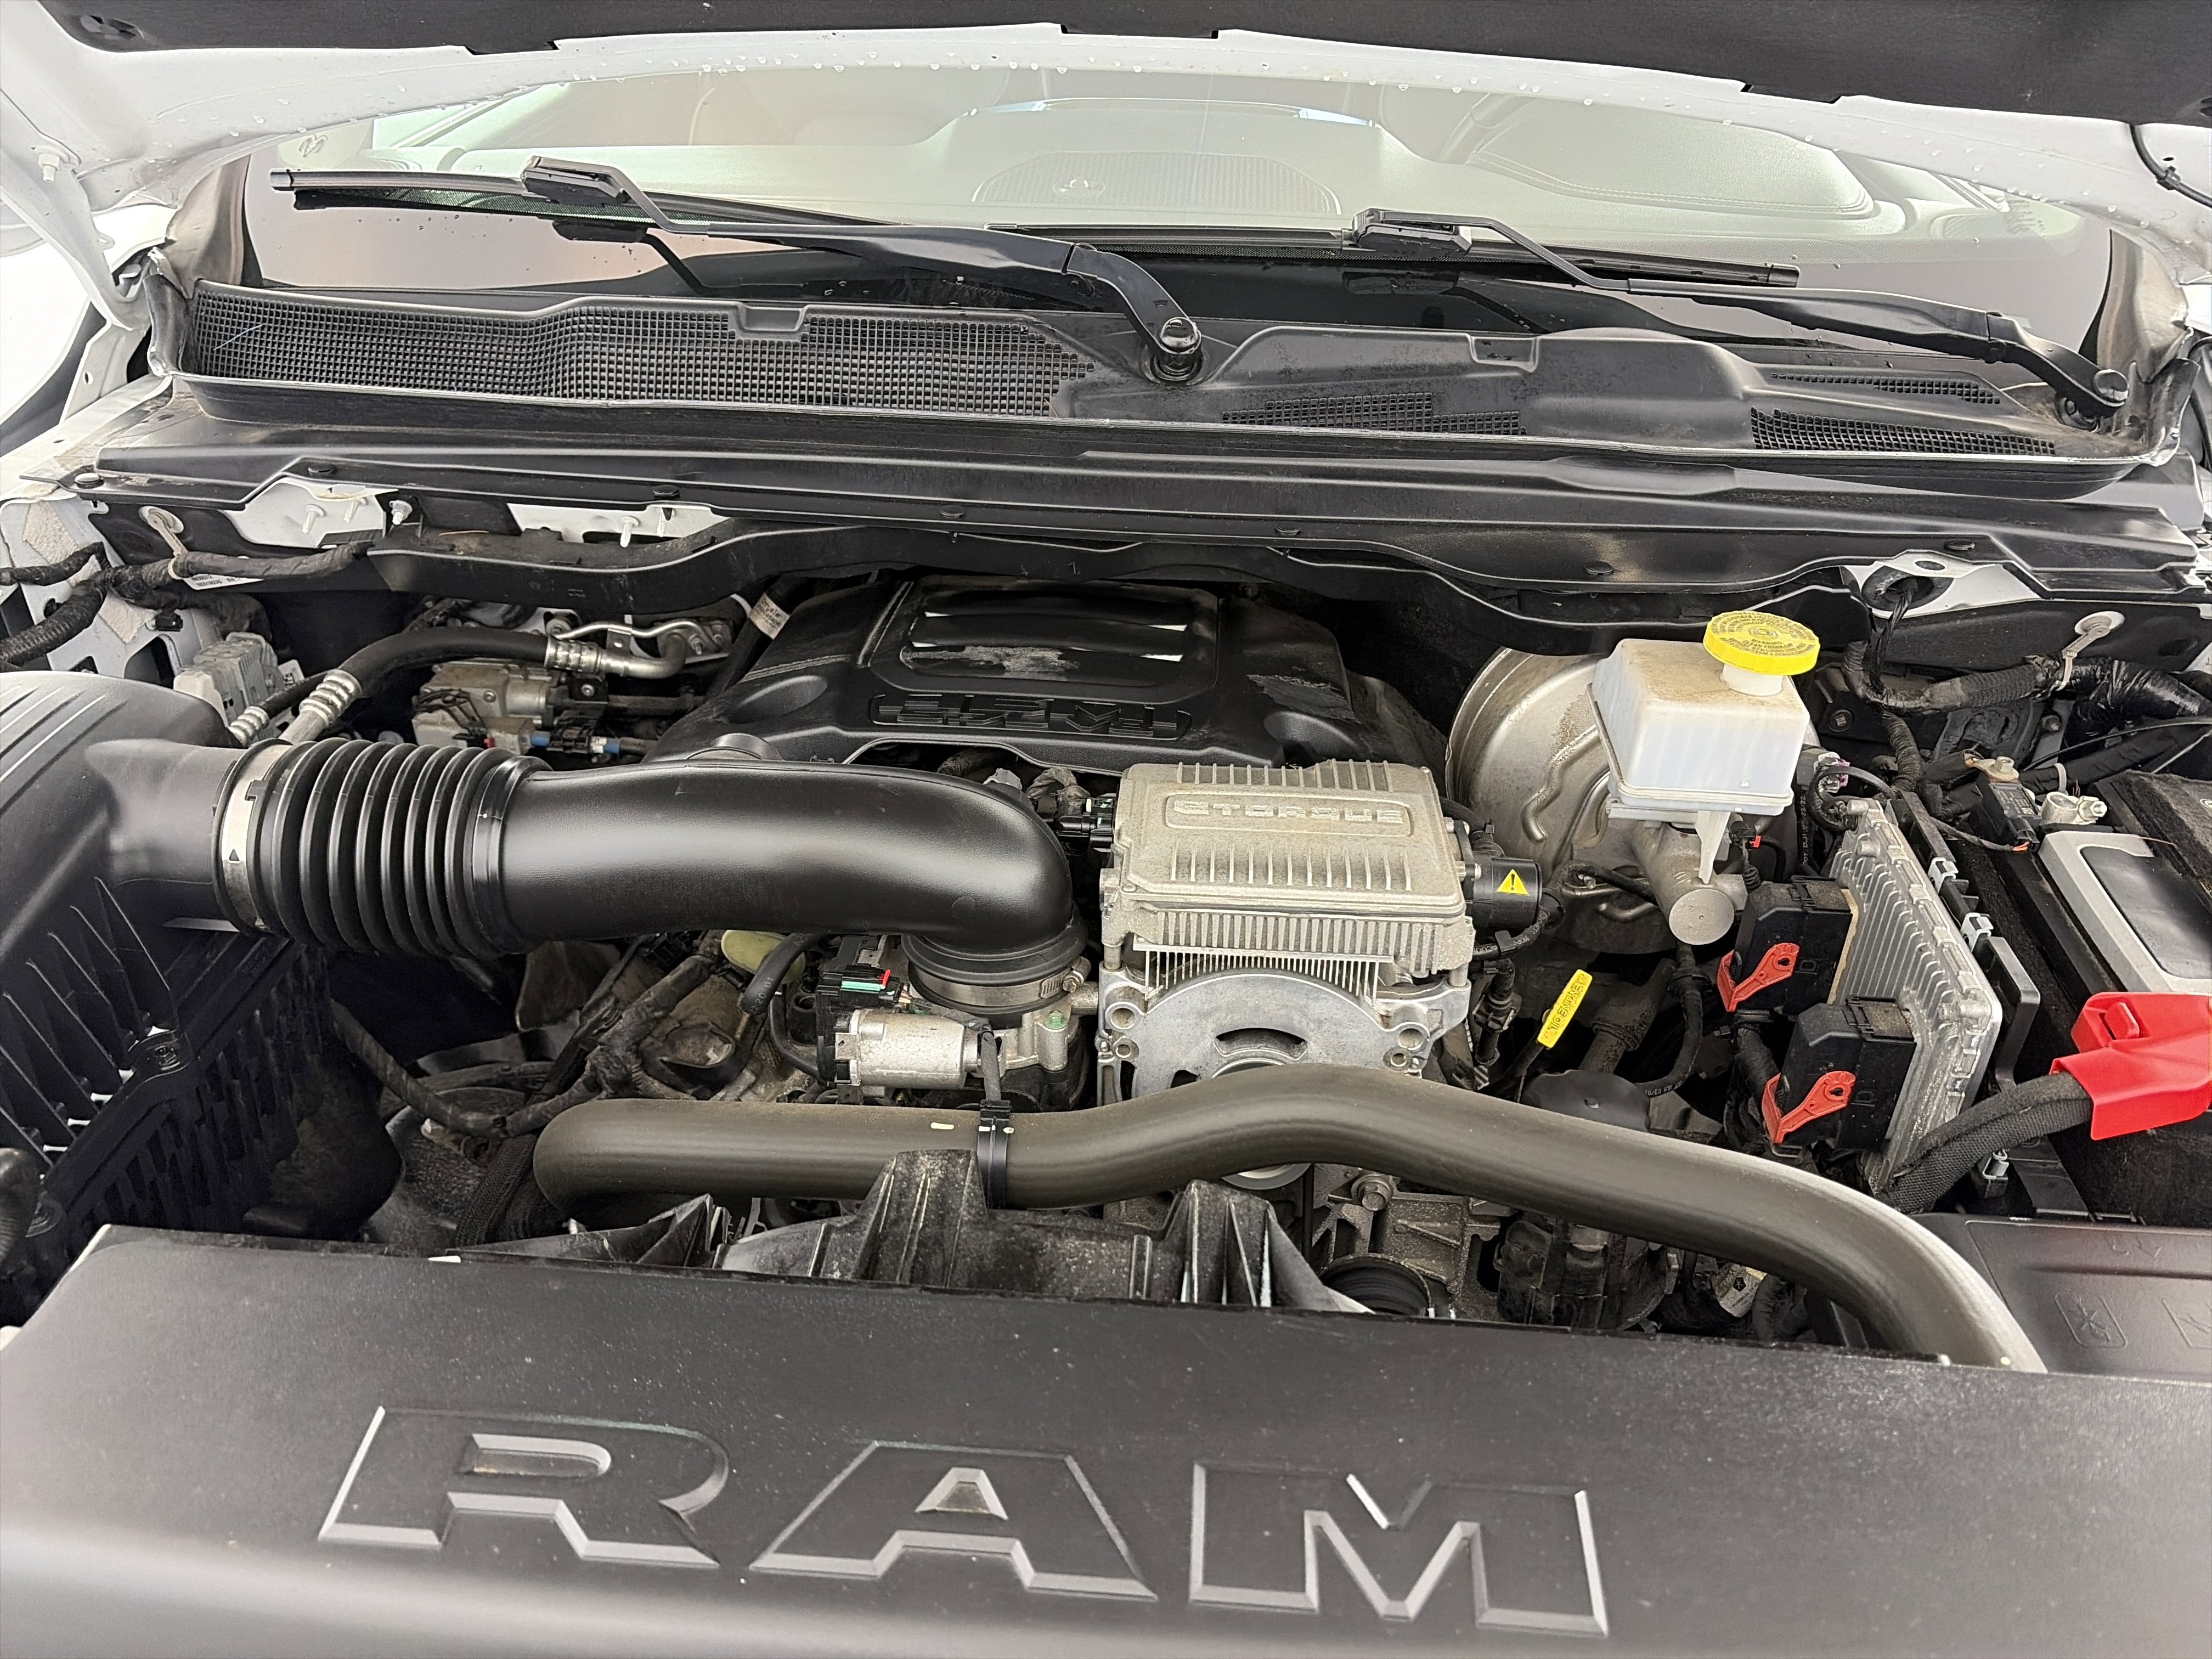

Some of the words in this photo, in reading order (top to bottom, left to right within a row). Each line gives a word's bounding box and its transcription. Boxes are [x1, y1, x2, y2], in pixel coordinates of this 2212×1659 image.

[1556, 983, 1583, 1017] ENGINE
[1547, 1015, 1562, 1030] OIL
[318, 1404, 1609, 1635] RAM
